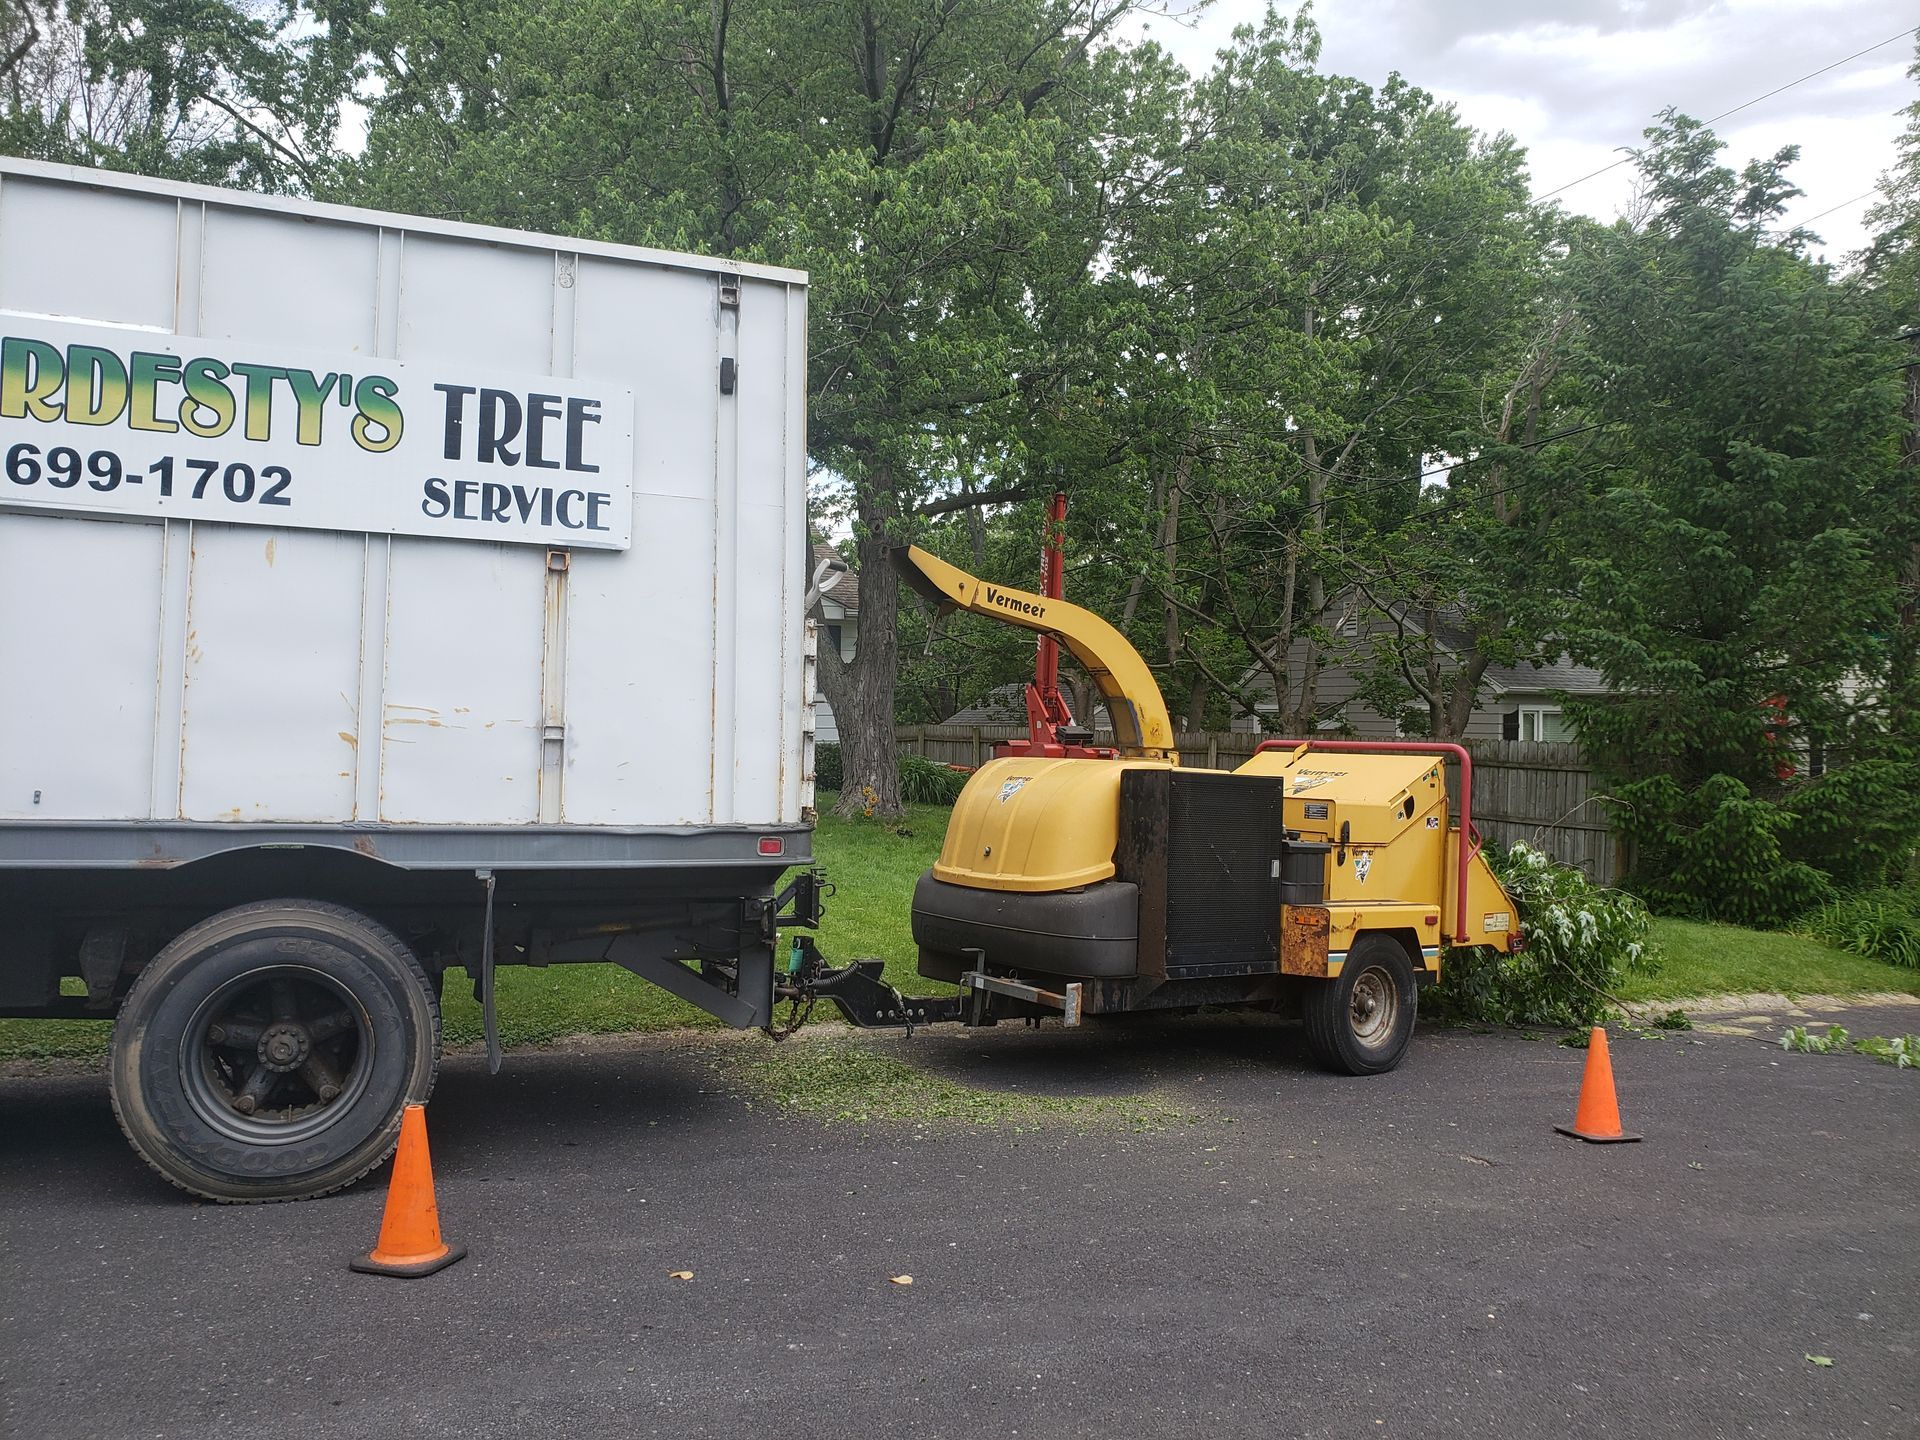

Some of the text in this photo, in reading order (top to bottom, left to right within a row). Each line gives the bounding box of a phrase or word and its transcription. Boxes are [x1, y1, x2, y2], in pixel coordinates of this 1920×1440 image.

[0, 336, 602, 473] RDESTY'S TREE
[5, 443, 292, 506] 699-1702
[421, 477, 611, 531] SERVICE
[986, 586, 1046, 618] Vermeer
